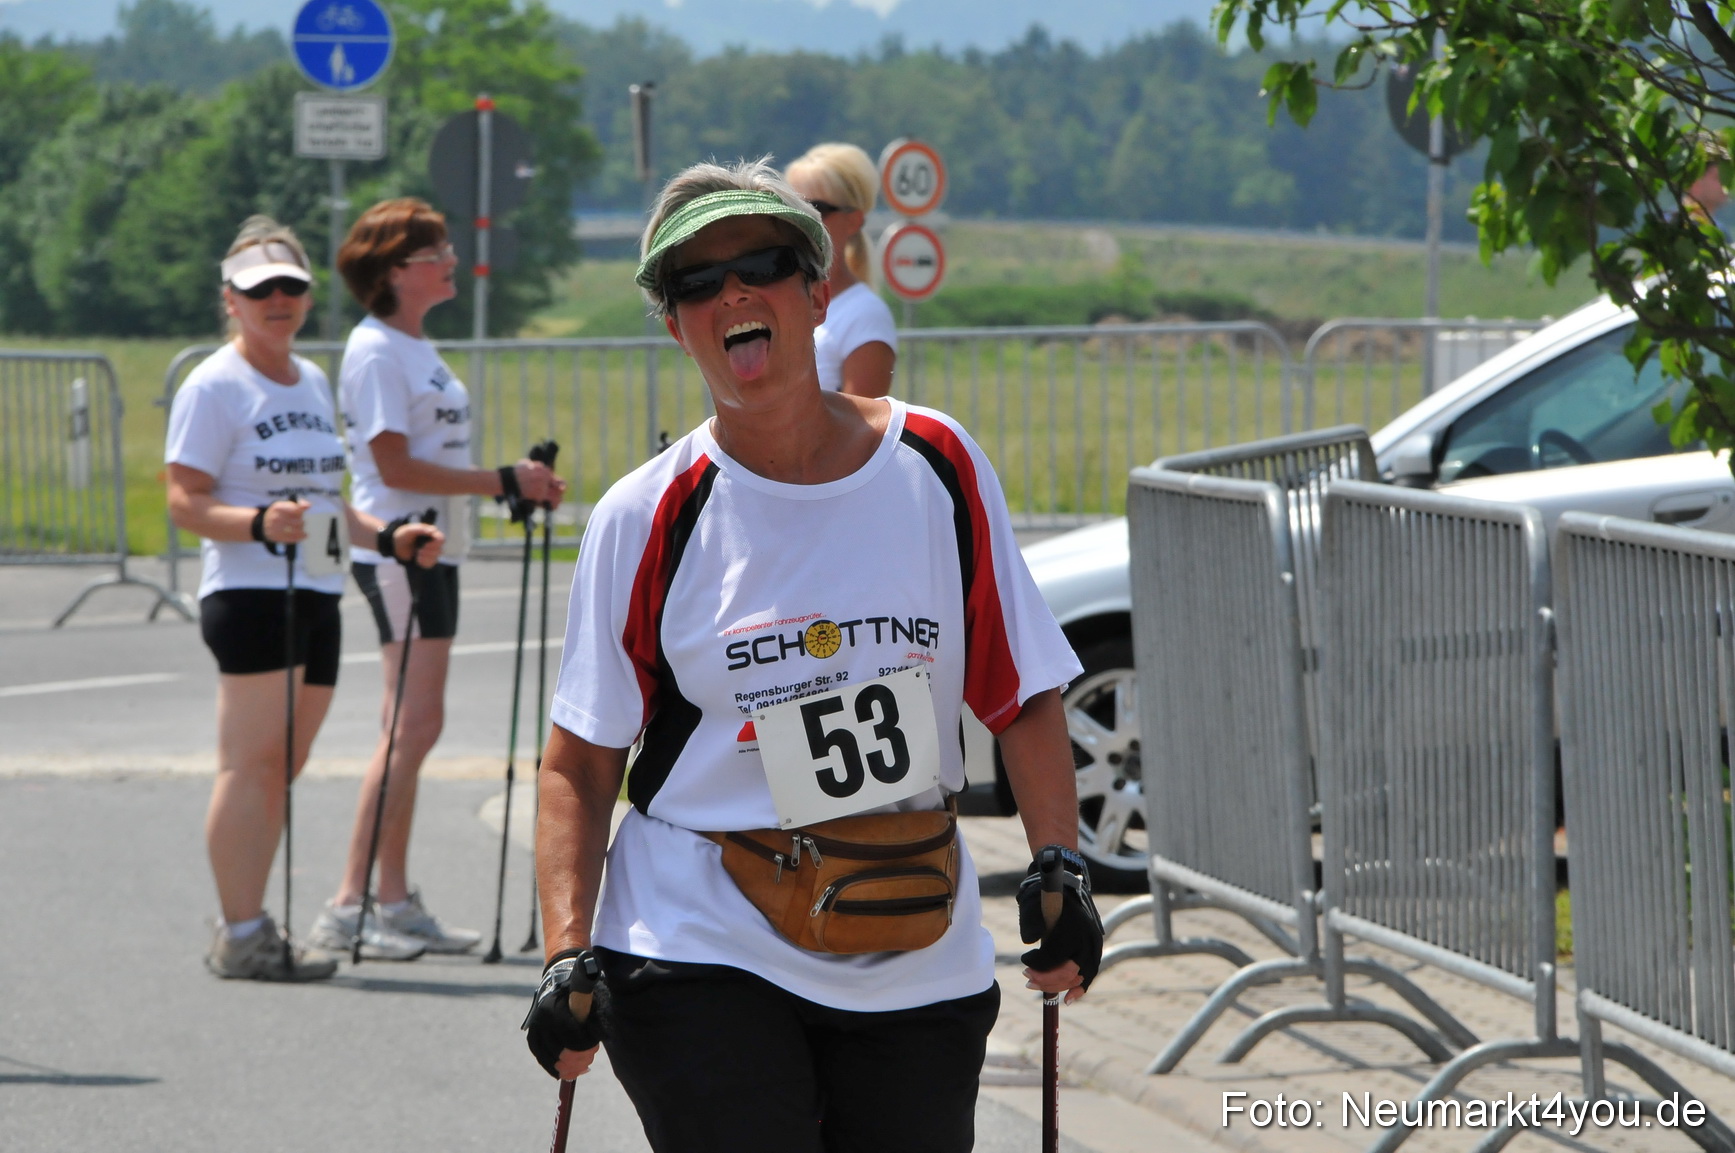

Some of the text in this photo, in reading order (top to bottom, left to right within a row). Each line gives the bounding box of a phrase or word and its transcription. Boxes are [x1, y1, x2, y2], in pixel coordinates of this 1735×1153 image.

[895, 163, 930, 196] 60
[255, 456, 315, 474] POWER
[326, 517, 342, 564] 4
[733, 622, 774, 634] kompetenter
[735, 671, 849, 703] Regensburger Str. 92
[800, 684, 911, 798] 53
